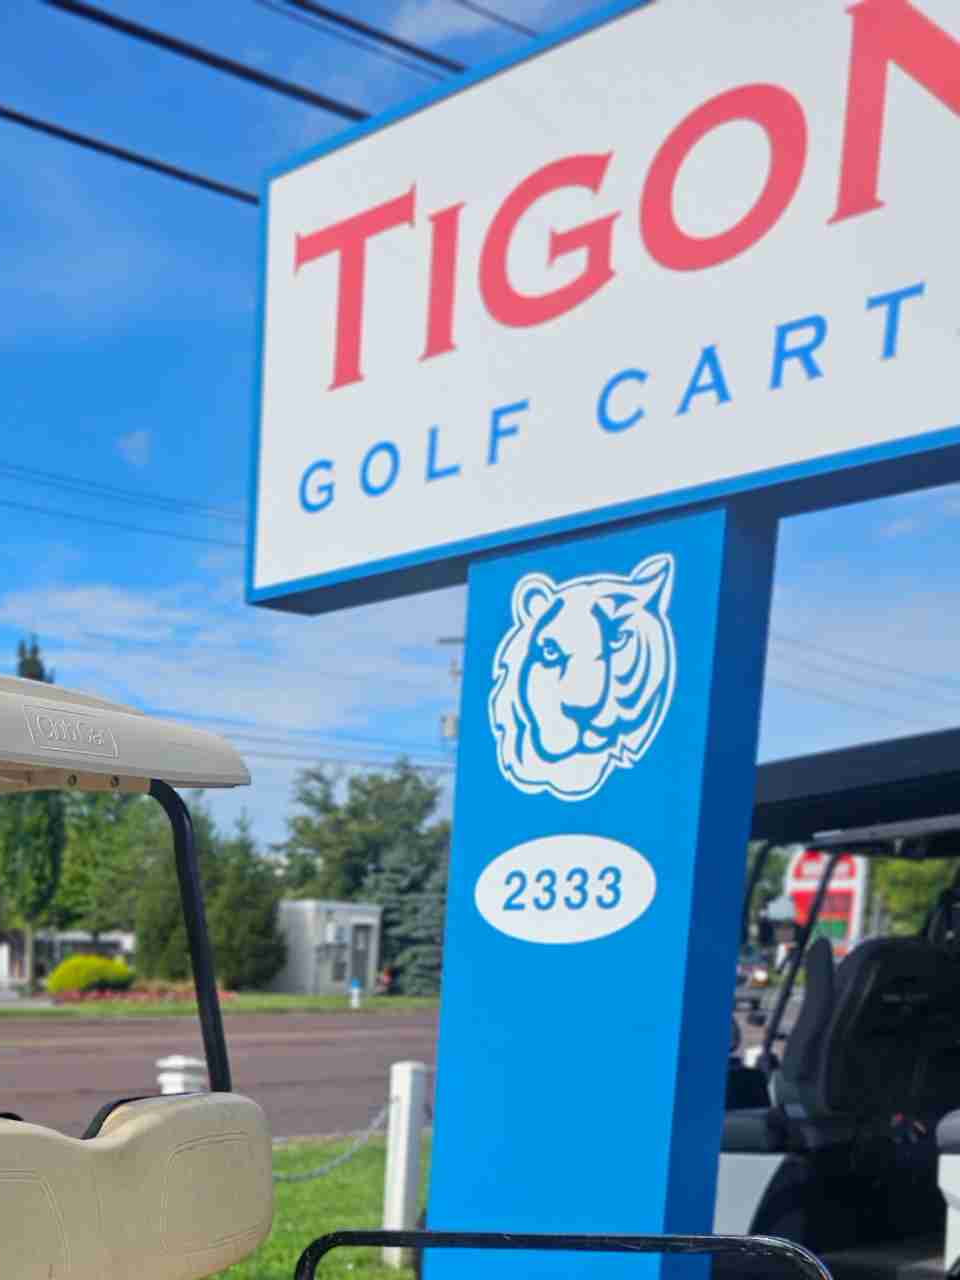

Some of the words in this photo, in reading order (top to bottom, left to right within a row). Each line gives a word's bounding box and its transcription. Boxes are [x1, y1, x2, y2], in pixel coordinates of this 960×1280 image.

[295, 0, 960, 390] TIGON
[299, 400, 528, 512] GOLF
[502, 867, 623, 911] 2333
